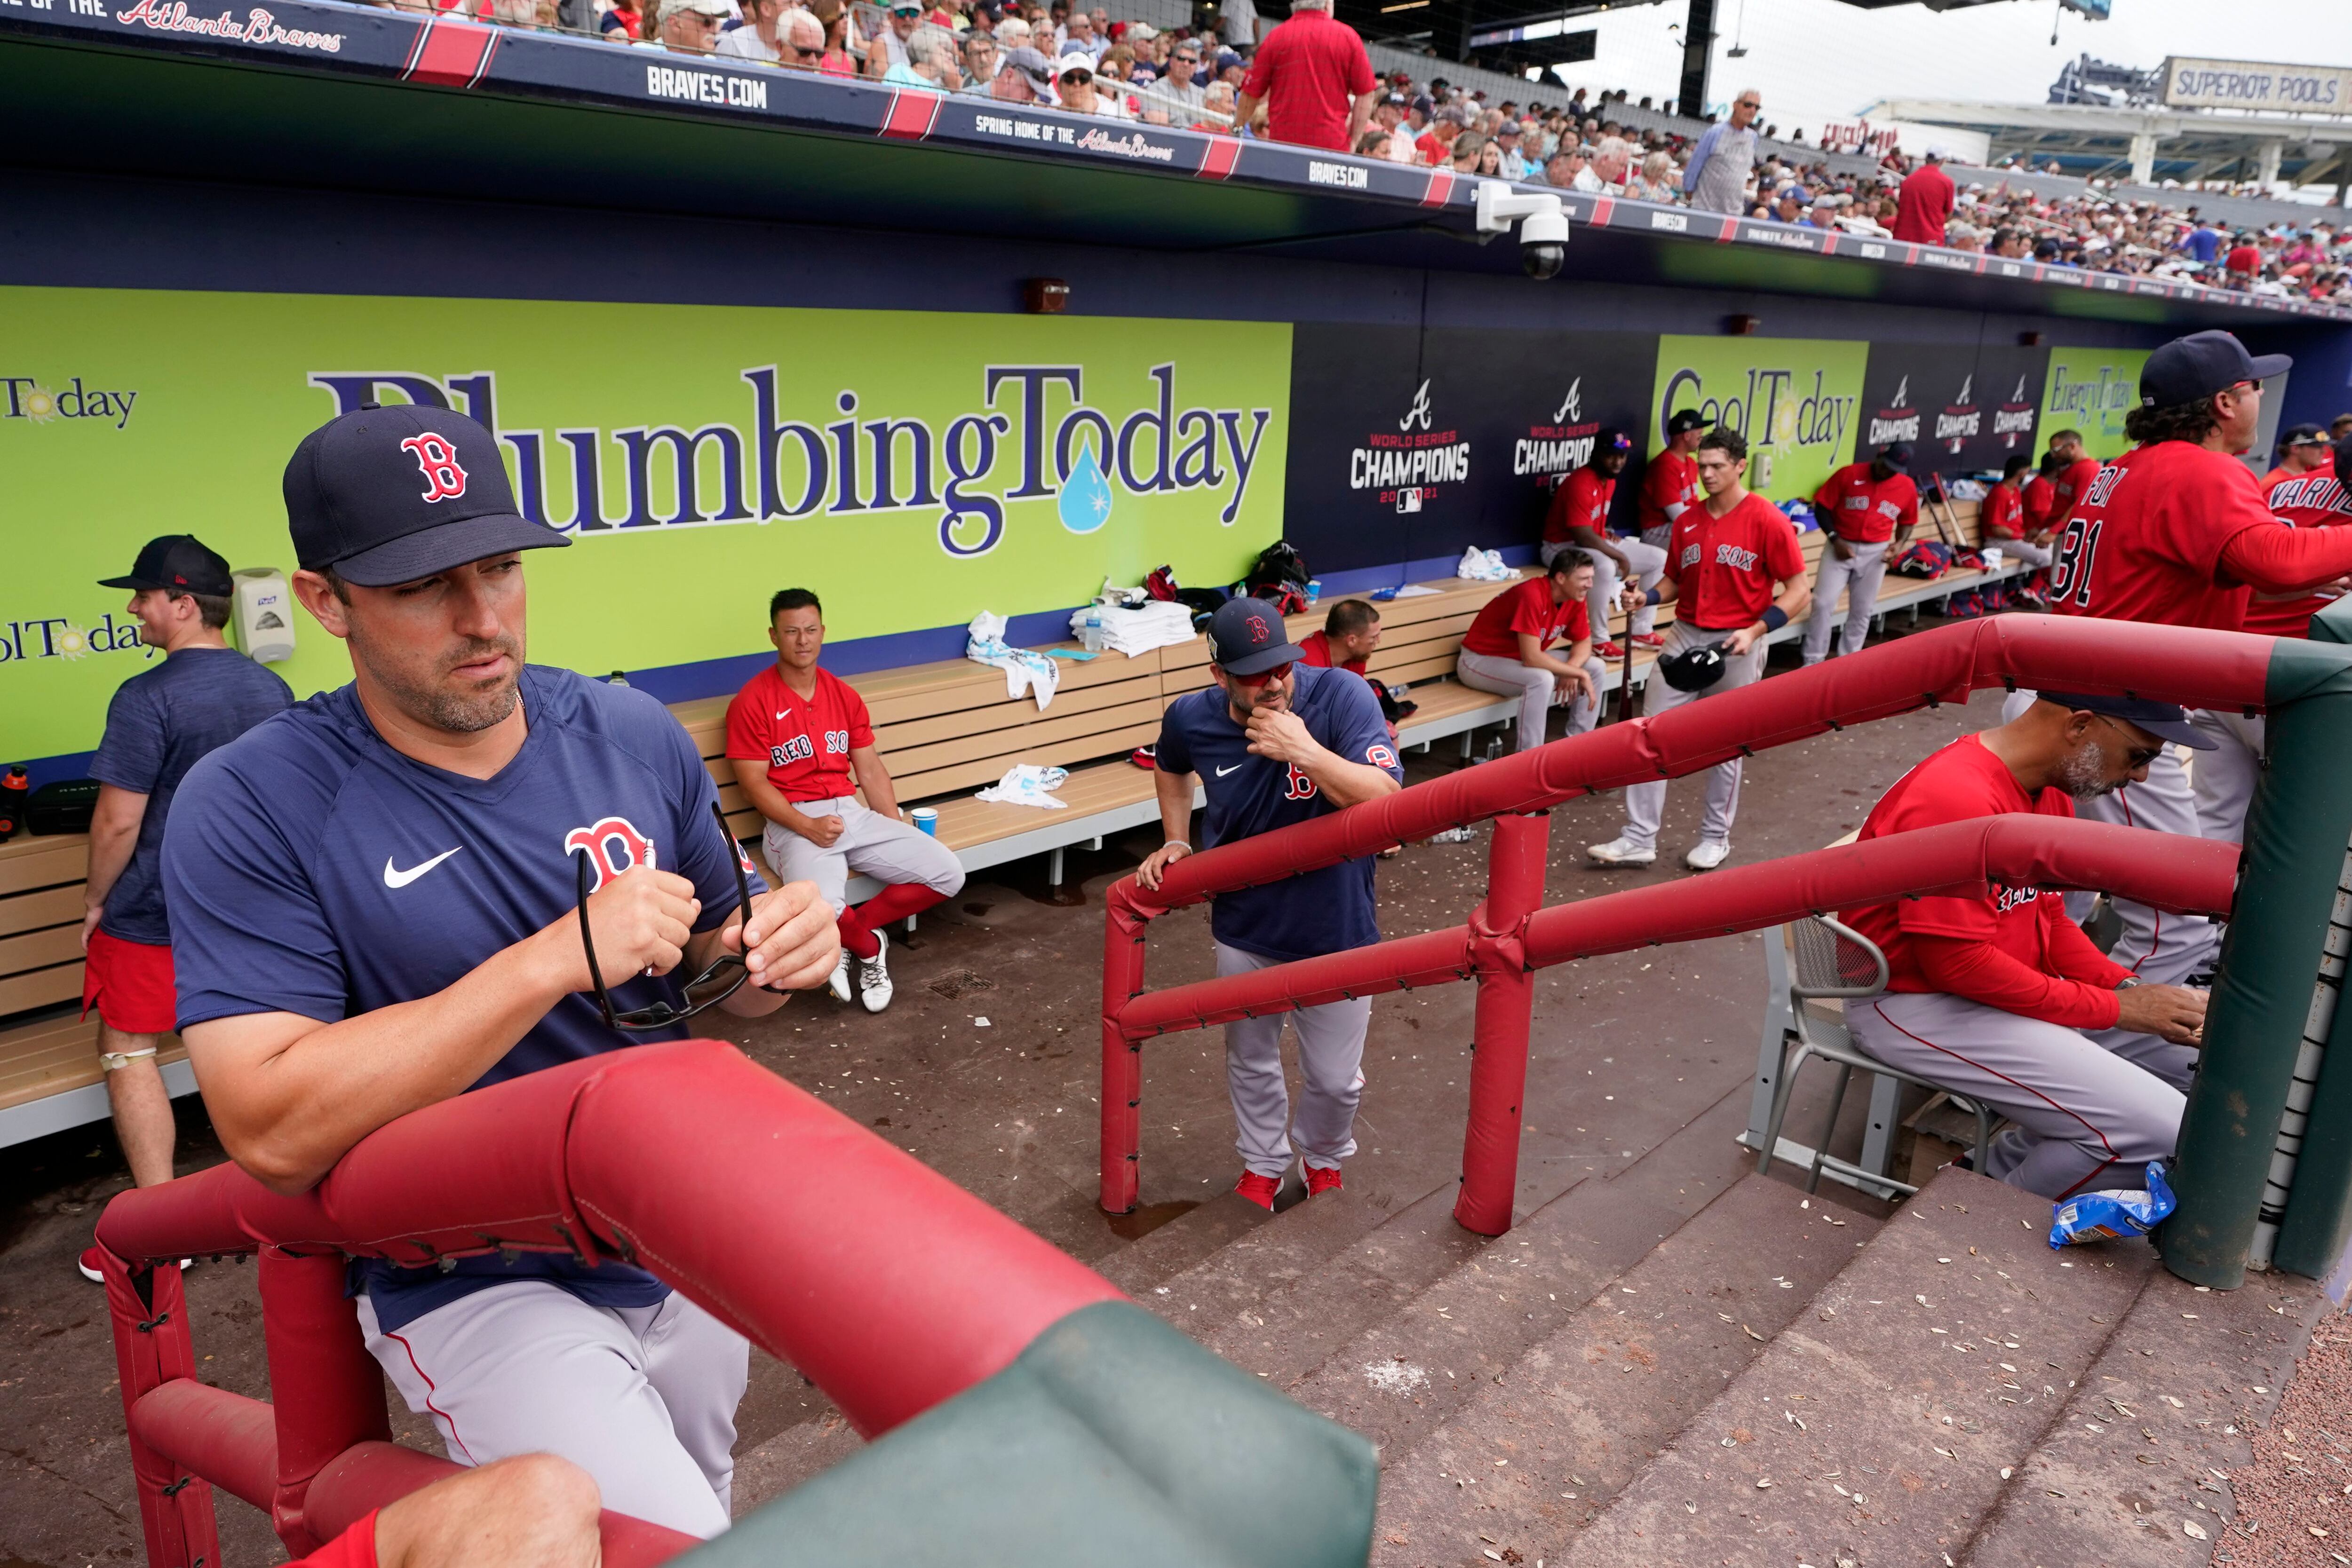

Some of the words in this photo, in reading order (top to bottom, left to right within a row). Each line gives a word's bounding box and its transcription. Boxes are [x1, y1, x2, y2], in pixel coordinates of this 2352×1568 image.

[117, 0, 243, 39] Atlanta
[242, 8, 341, 53] Braves
[647, 65, 767, 109] BRAVES.COM
[2177, 70, 2272, 101] SUPERIOR
[2278, 76, 2338, 104] POOLS
[976, 115, 1013, 136] SPRING
[1015, 120, 1041, 140] HOME
[1042, 125, 1055, 142] OF
[1057, 127, 1075, 144] THE
[1077, 128, 1132, 156] Atlanta
[1370, 433, 1413, 448] WORLD
[1414, 430, 1457, 446] SERIES
[1530, 425, 1565, 438] WORLD
[307, 362, 1271, 558] umbingToday
[400, 432, 469, 503] B
[1350, 442, 1470, 490] CHAMPIONS
[1514, 436, 1596, 475] CHAMPIO
[1715, 544, 1759, 572] SOX
[1246, 615, 1270, 643] B
[771, 734, 814, 767] RED
[824, 729, 849, 754] SO
